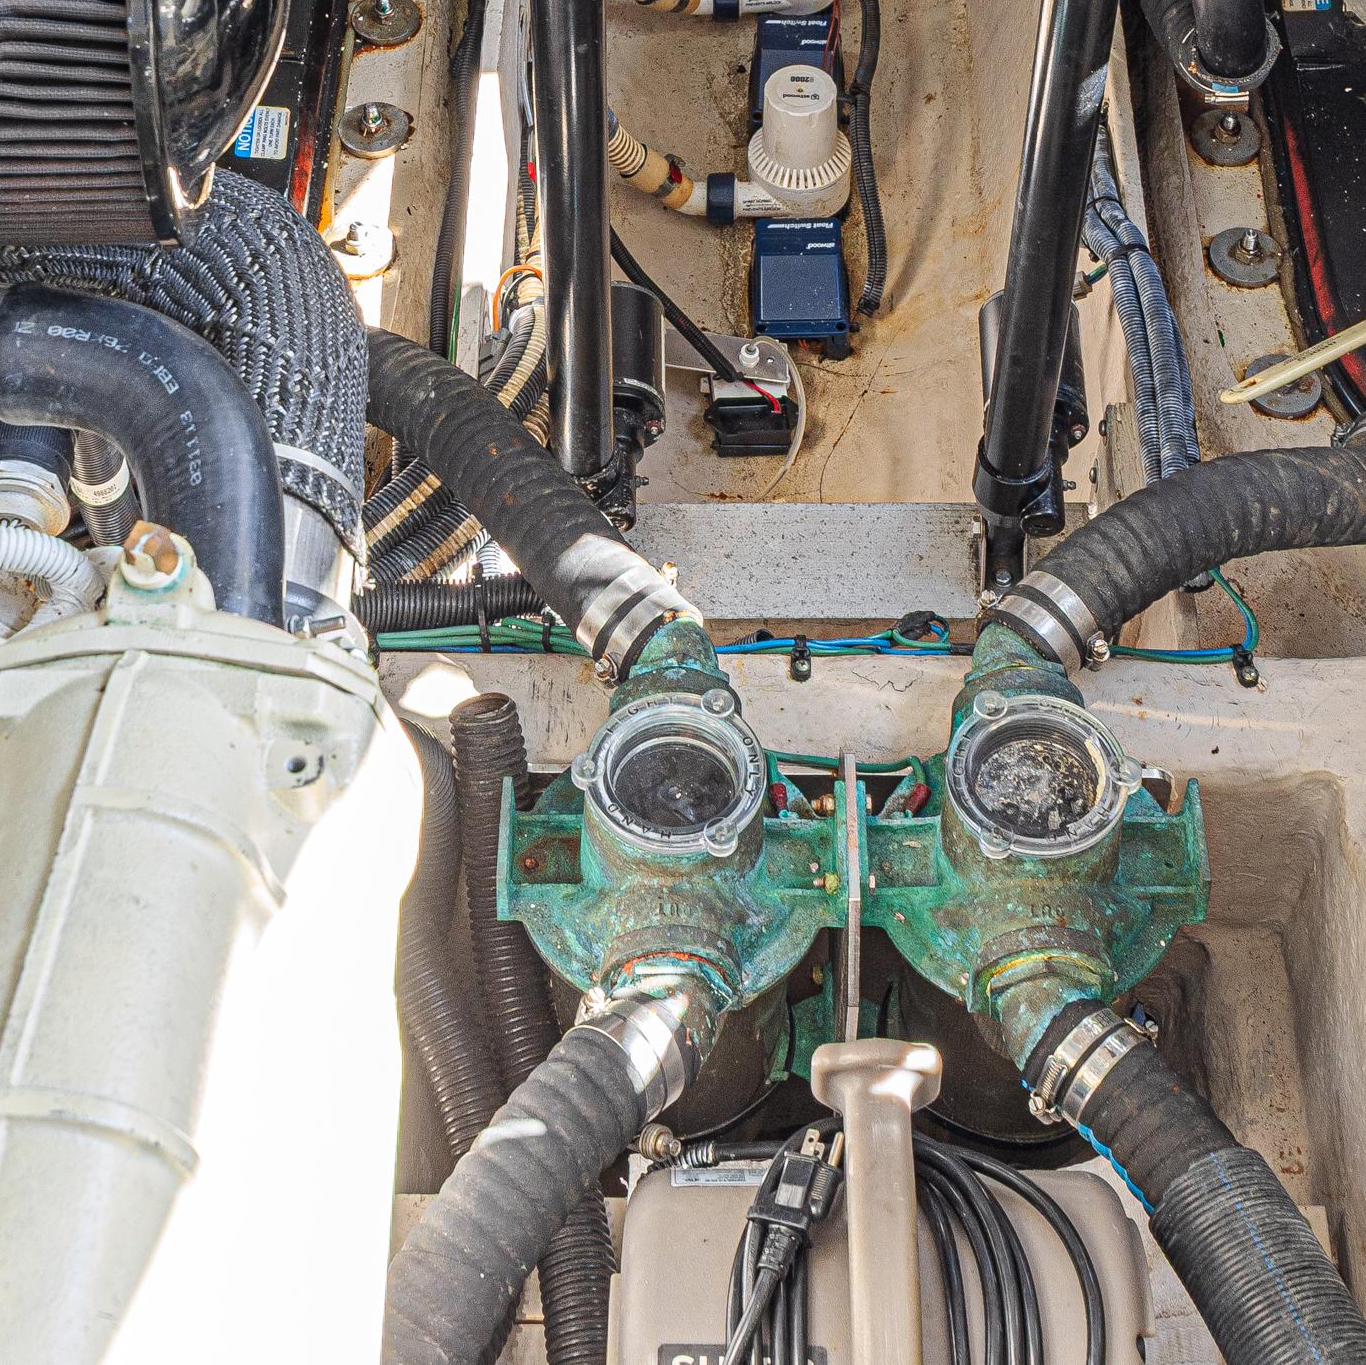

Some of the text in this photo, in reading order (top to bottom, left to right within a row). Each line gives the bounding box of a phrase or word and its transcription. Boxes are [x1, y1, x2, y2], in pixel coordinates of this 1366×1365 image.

[781, 19, 807, 27] Switch
[237, 116, 254, 151] NOTIC
[806, 242, 835, 250] attwood
[743, 736, 760, 798] ONLY
[607, 802, 672, 840] HAND
